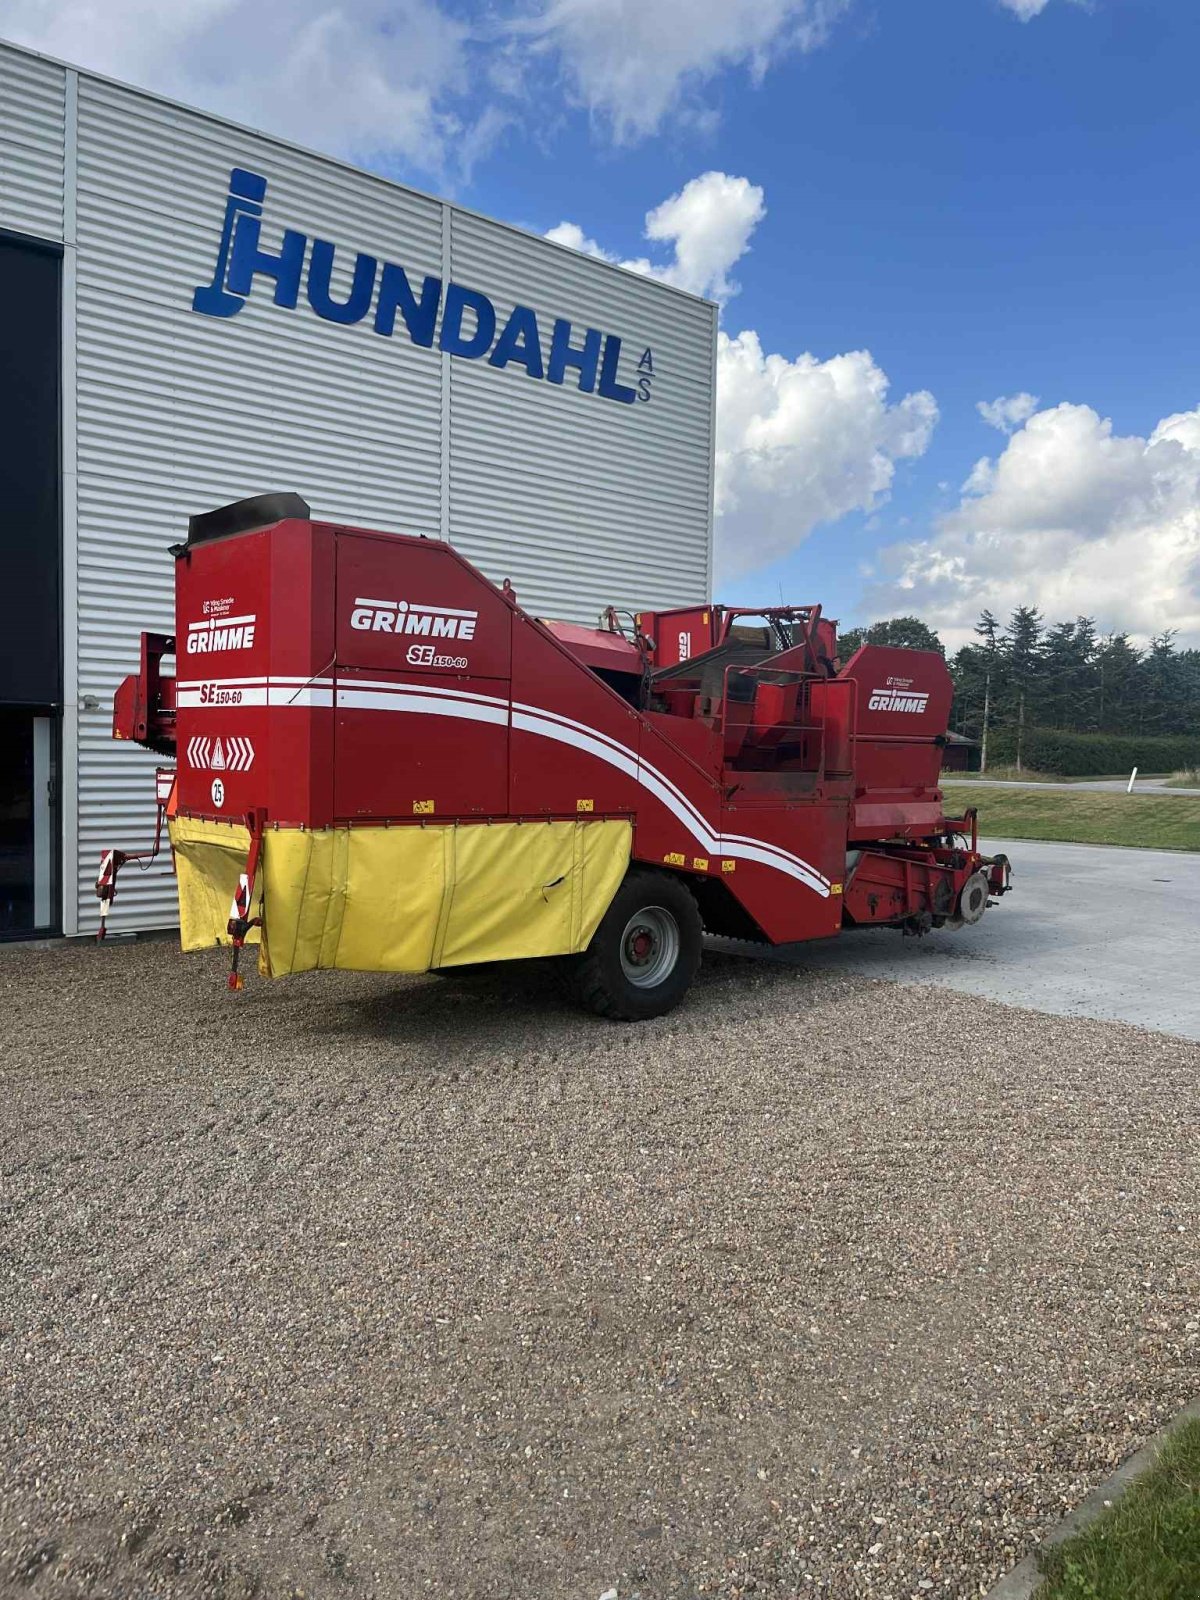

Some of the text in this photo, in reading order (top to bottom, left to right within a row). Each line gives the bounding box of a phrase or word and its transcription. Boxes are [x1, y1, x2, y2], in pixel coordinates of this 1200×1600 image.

[350, 608, 476, 640] GRIMME
[187, 626, 255, 653] GRIMME
[200, 684, 216, 703] SE
[868, 696, 927, 713] GRIMME
[214, 784, 221, 802] 25
